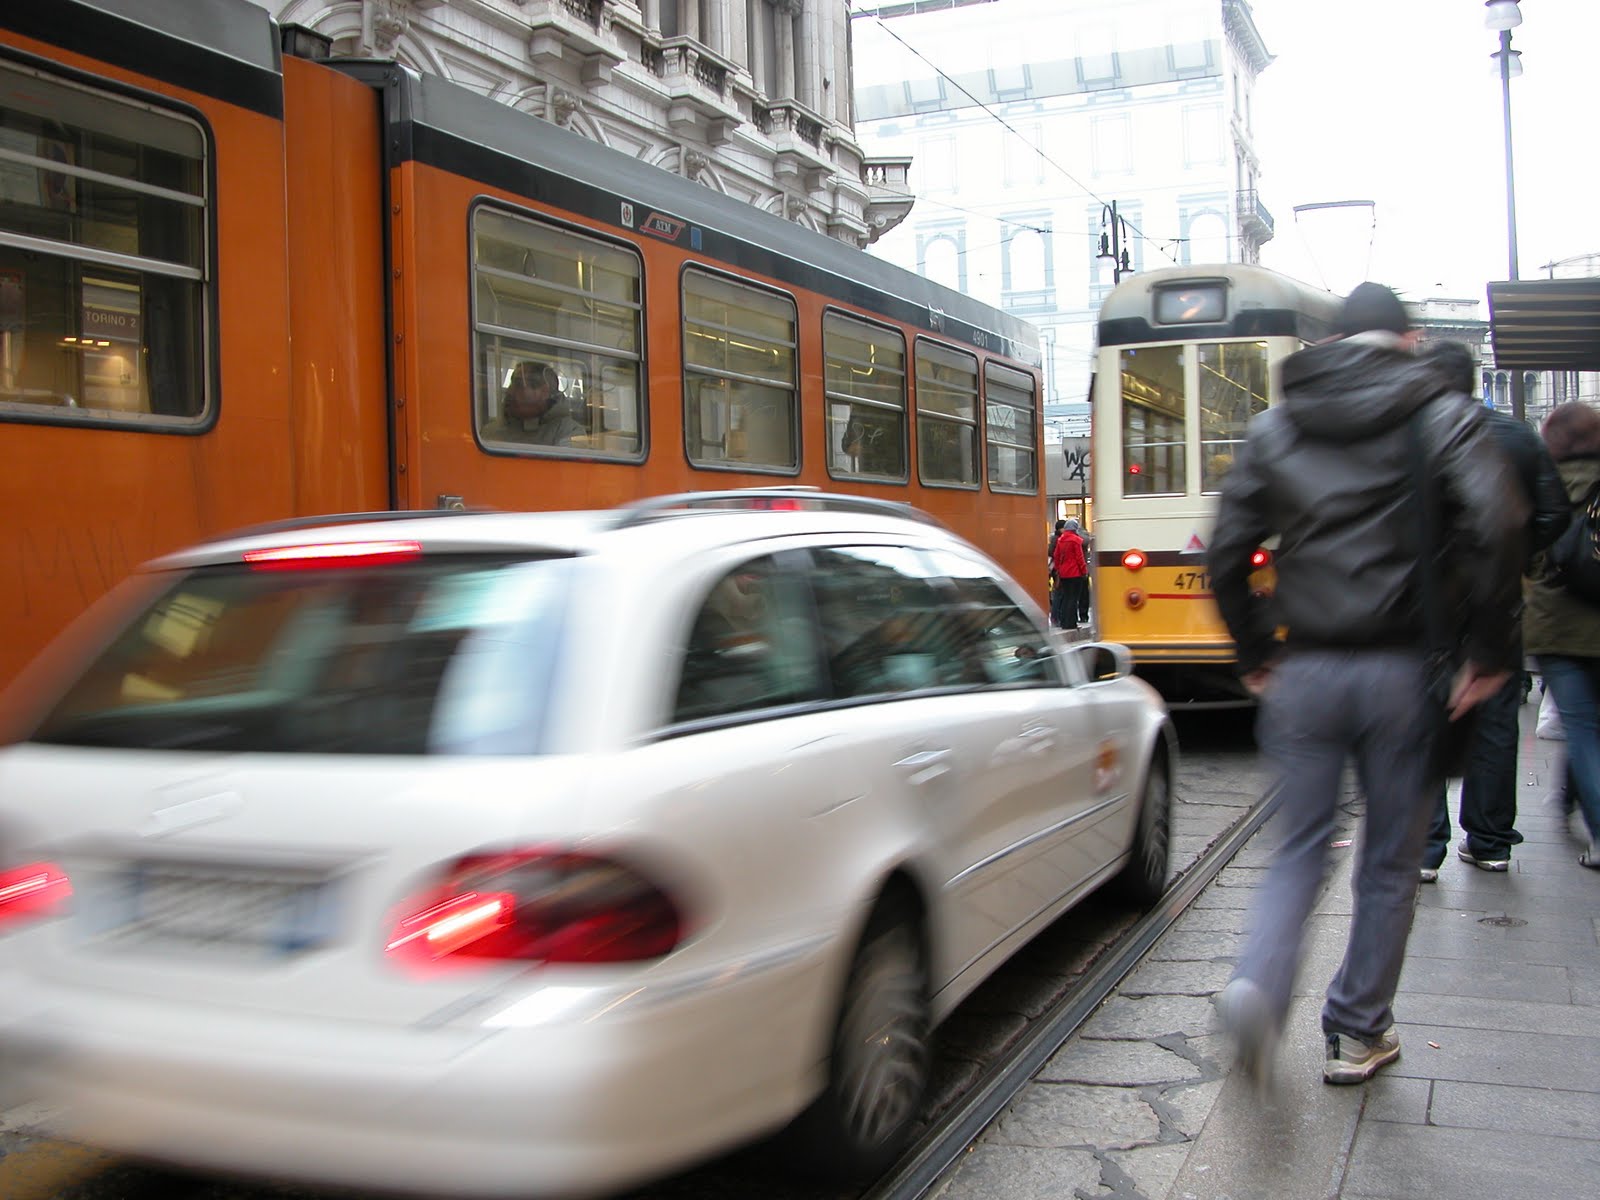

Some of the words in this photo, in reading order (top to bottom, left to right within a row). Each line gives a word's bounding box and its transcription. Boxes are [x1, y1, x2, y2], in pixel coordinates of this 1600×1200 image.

[655, 220, 672, 234] ATM
[85, 311, 126, 326] TORINO
[130, 317, 137, 328] 2
[972, 329, 989, 348] 4901
